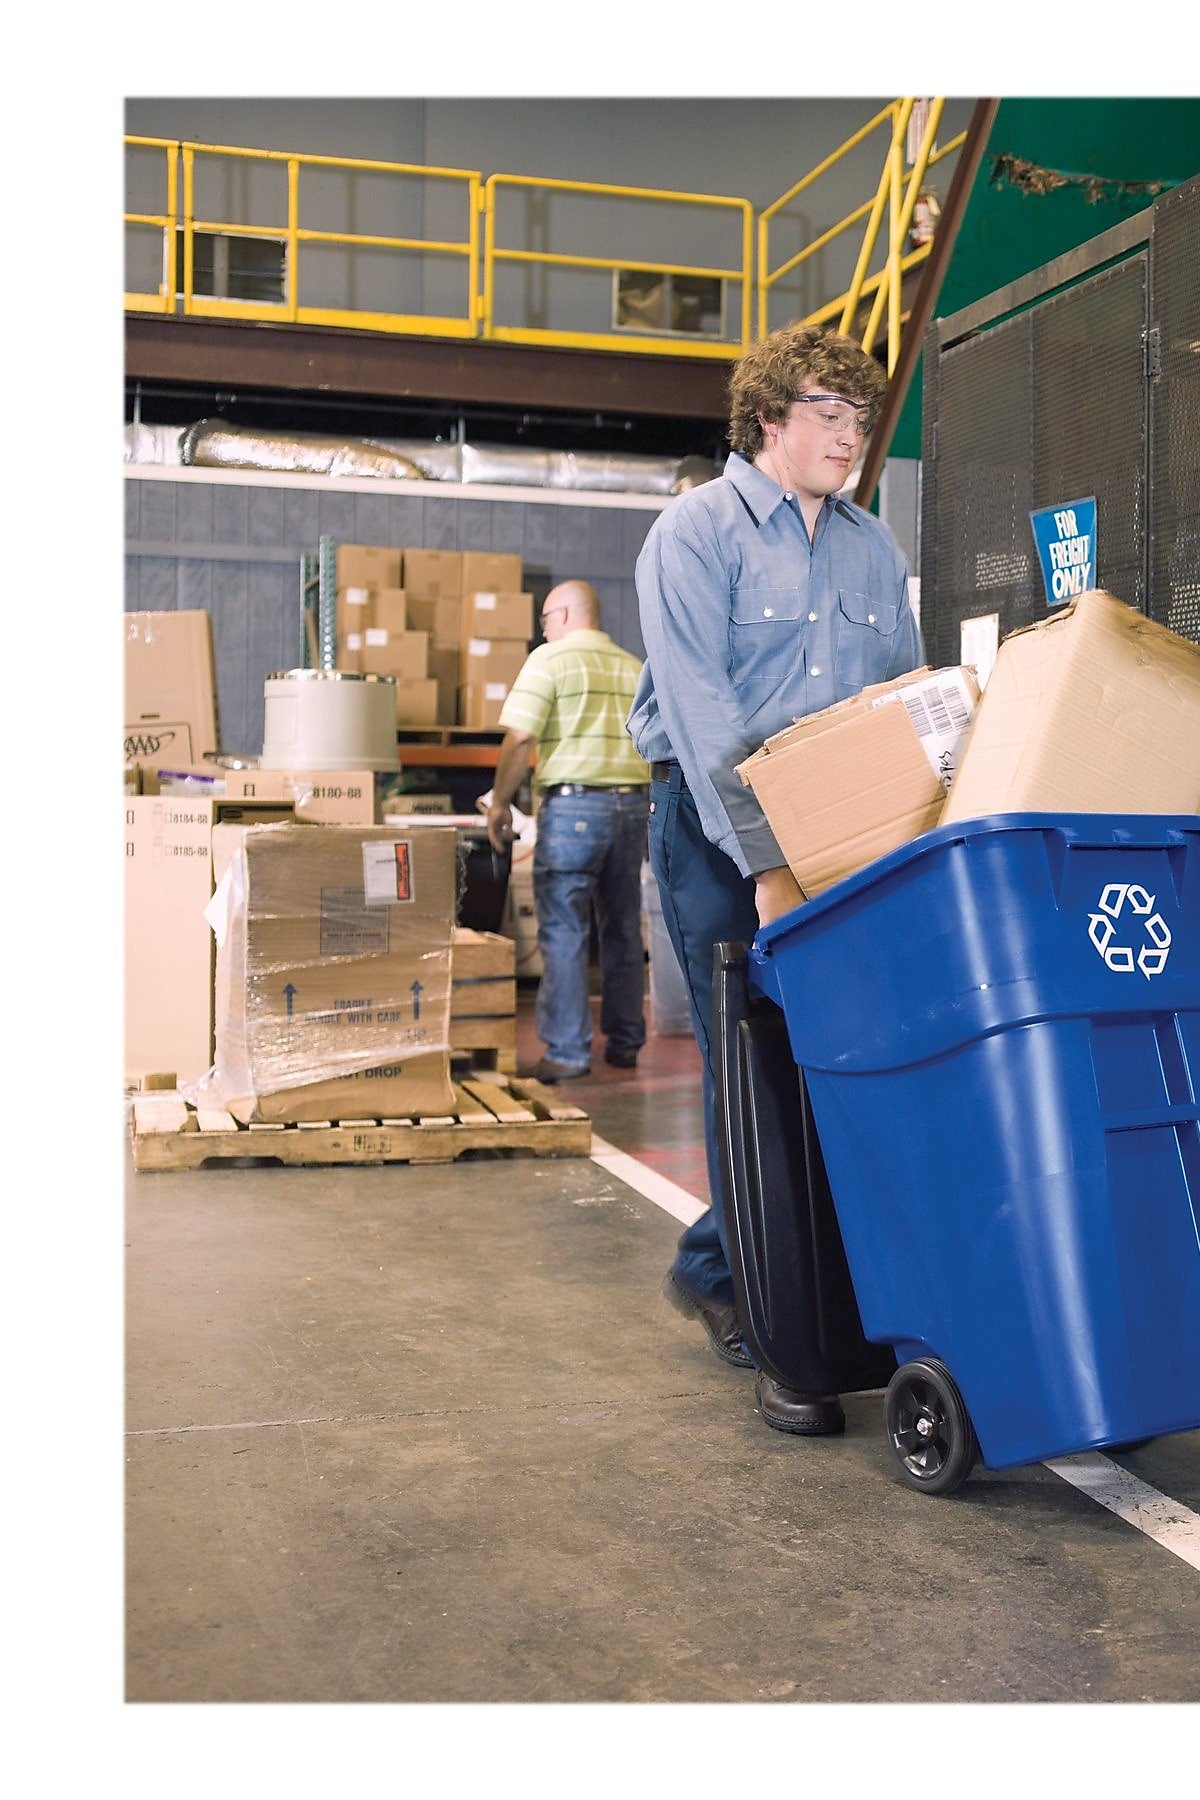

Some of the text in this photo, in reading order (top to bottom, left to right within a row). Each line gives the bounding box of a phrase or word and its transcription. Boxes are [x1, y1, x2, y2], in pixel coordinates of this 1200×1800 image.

[1053, 509, 1079, 539] FOR
[1048, 534, 1090, 569] FREIGHT
[1051, 562, 1091, 599] ONLY
[365, 1065, 403, 1079] DROP
